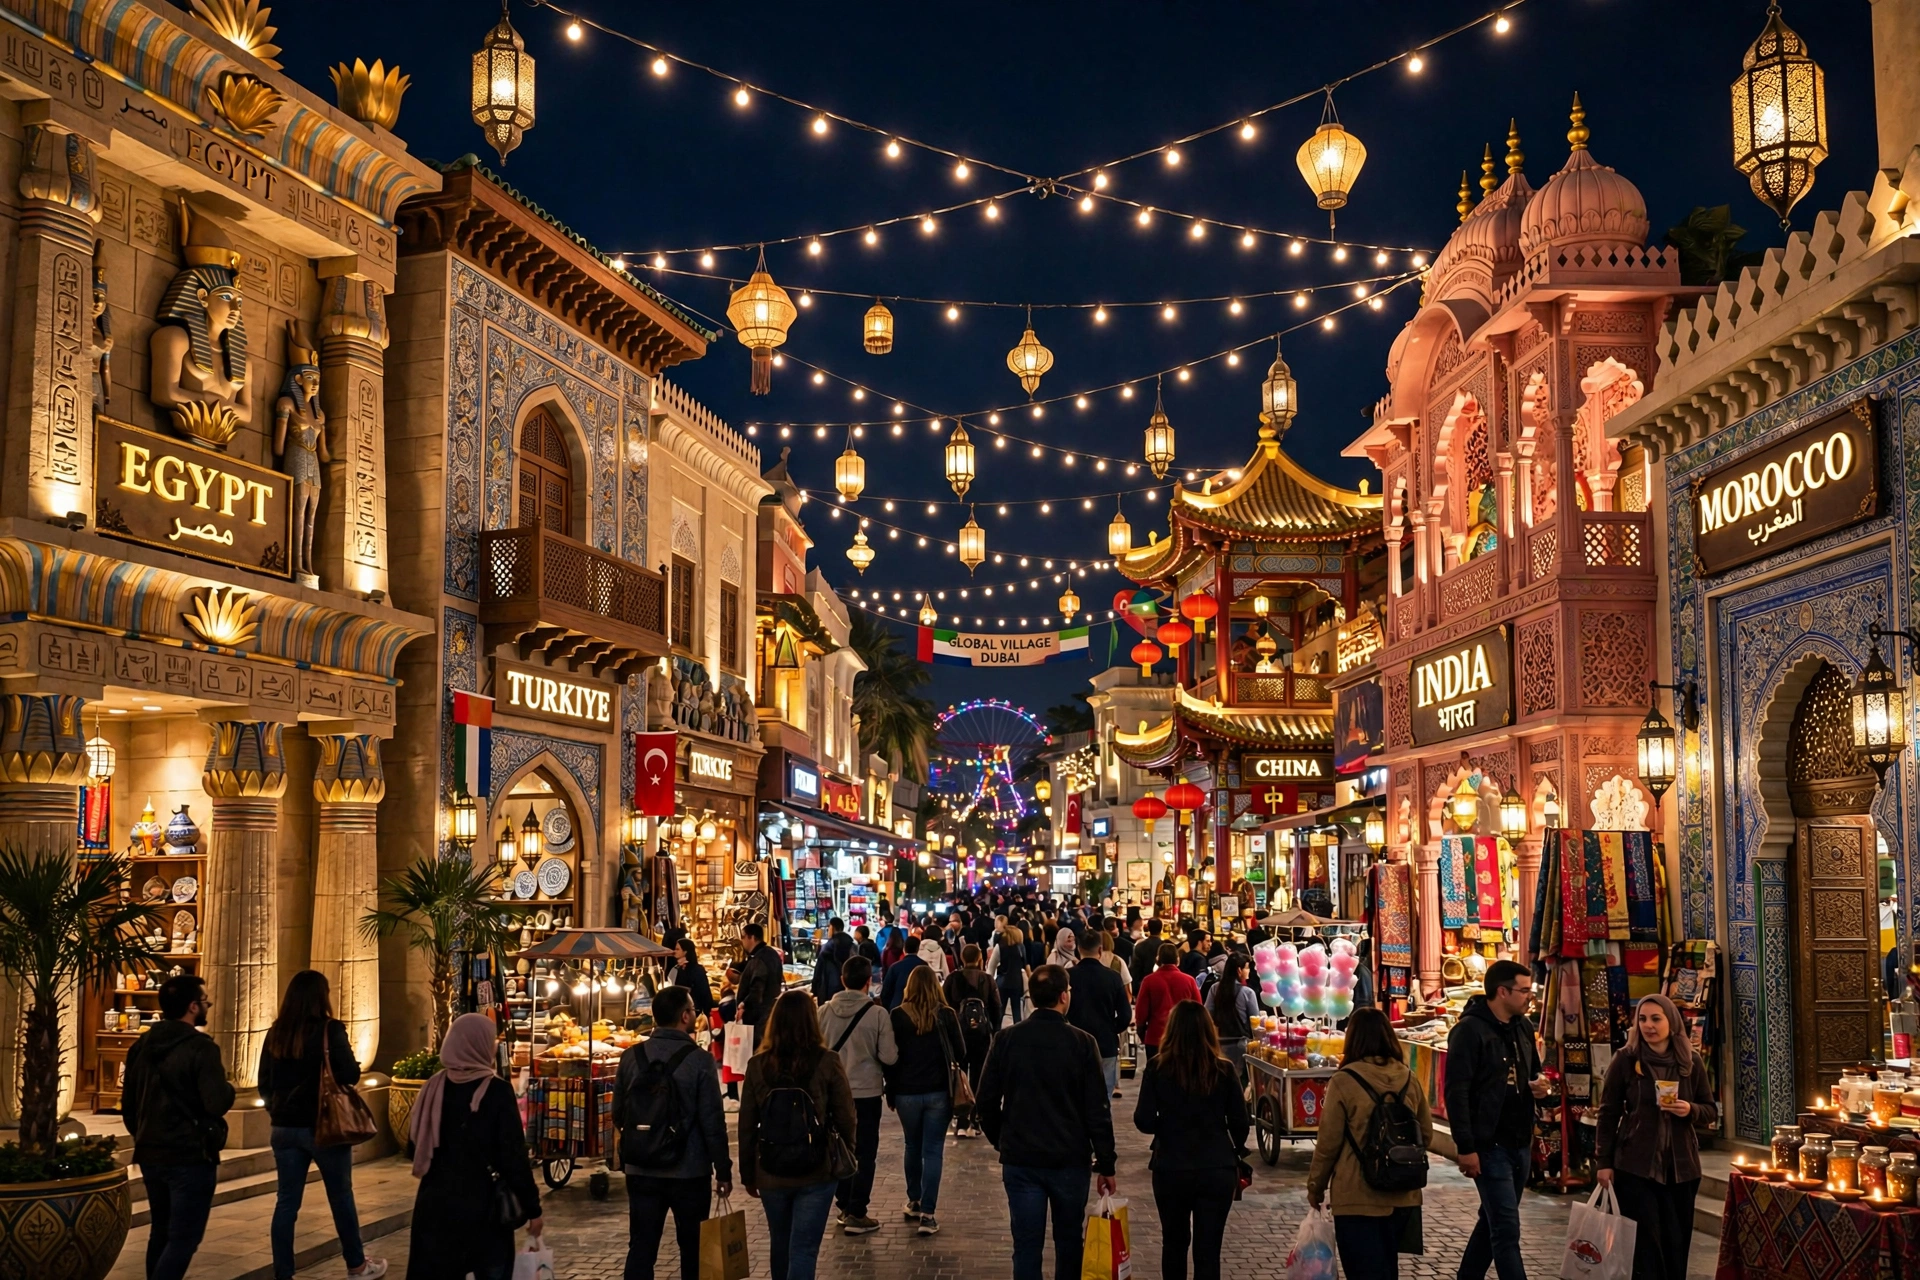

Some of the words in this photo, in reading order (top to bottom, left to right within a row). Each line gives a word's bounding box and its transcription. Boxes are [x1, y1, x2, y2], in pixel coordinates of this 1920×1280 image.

[120, 98, 168, 129] مصر
[186, 128, 278, 202] EGYPT
[118, 441, 274, 526] EGYPT
[1699, 432, 1853, 535] MOROCCO
[168, 517, 234, 546] مصر
[1747, 498, 1803, 546] المغرب
[949, 637, 997, 650] GLOBAL
[1000, 637, 1051, 650] VILLAGE
[981, 652, 1019, 663] DUBAI
[507, 670, 611, 722] TURKIYE
[1416, 644, 1493, 708] INDIA
[1437, 699, 1477, 732] भारत
[1255, 759, 1322, 777] CHINA
